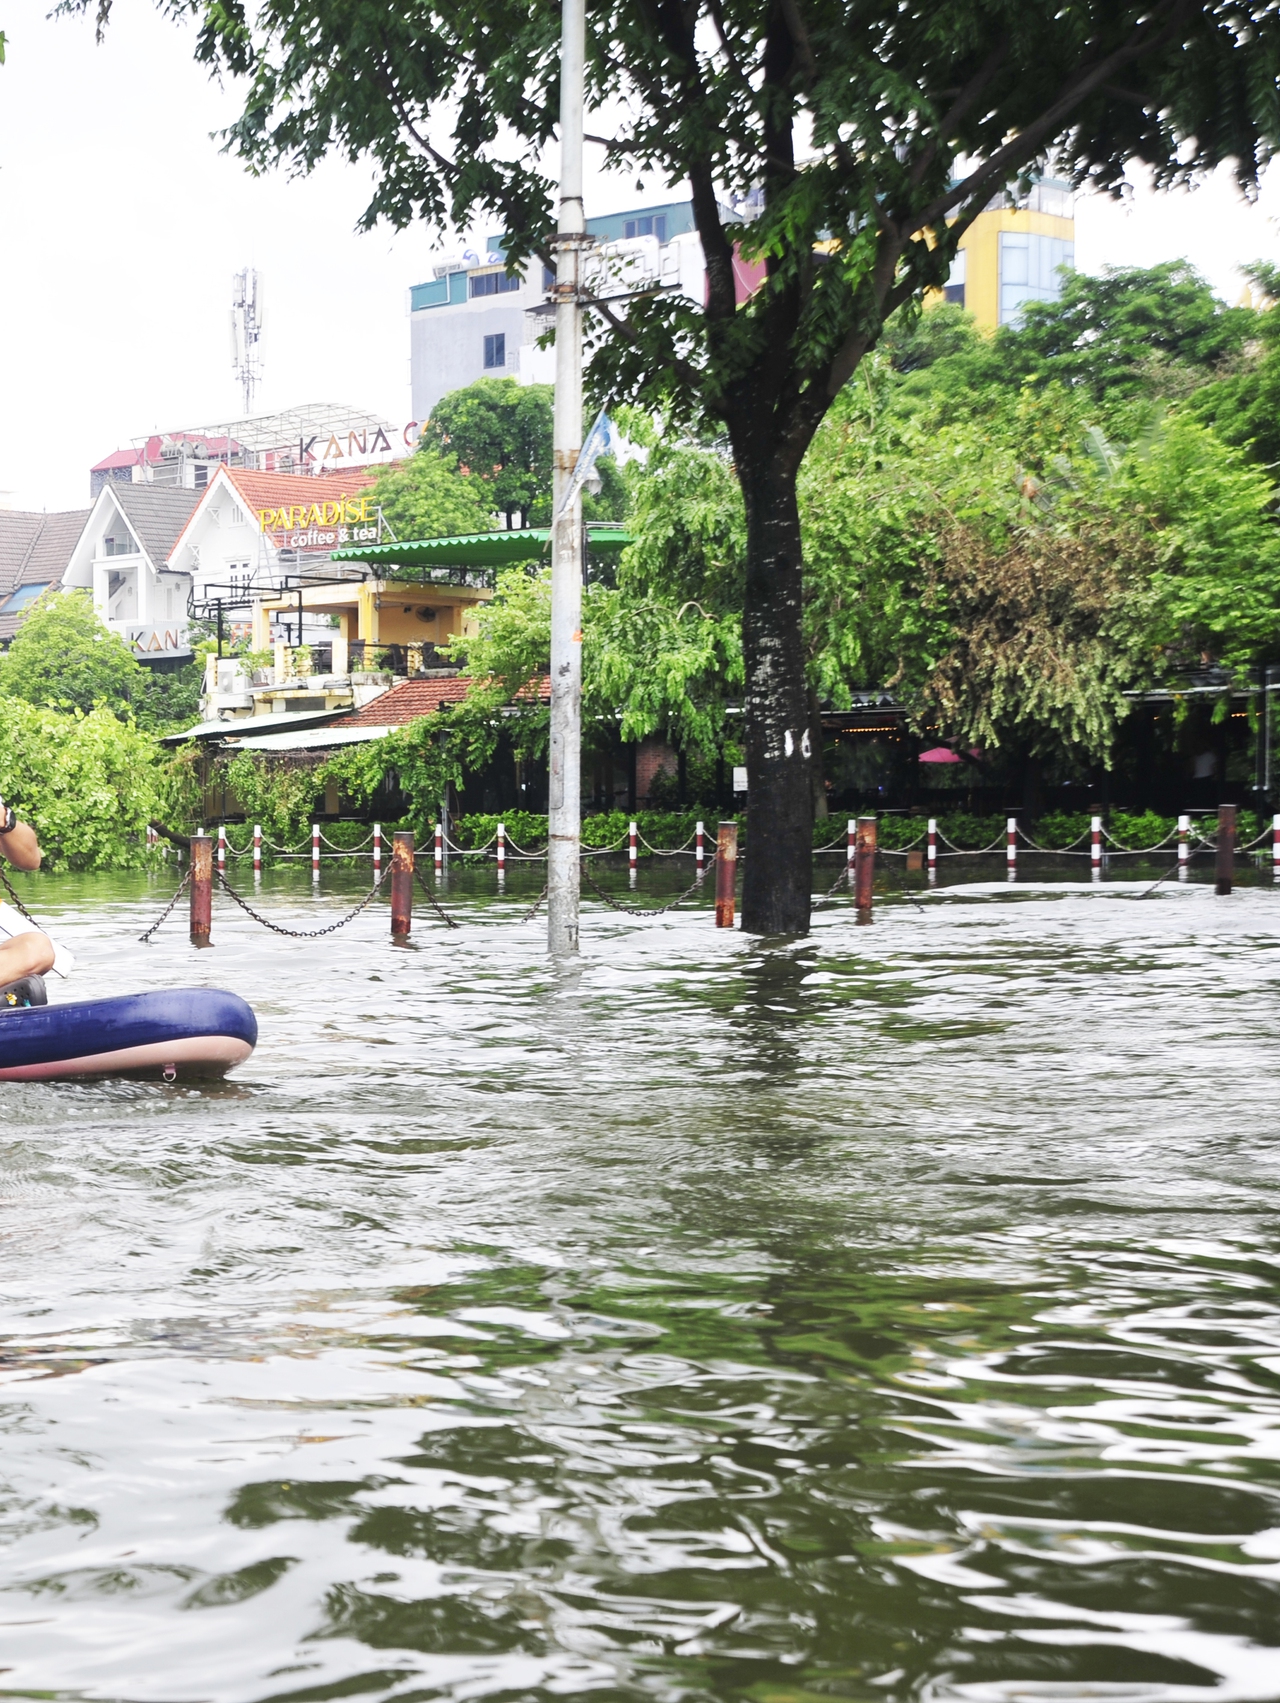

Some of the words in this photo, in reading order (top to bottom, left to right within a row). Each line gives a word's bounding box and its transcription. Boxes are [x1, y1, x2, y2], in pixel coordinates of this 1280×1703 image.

[299, 426, 392, 462] KANA
[291, 528, 334, 548] coffee
[338, 528, 349, 542] &
[353, 526, 377, 540] tea
